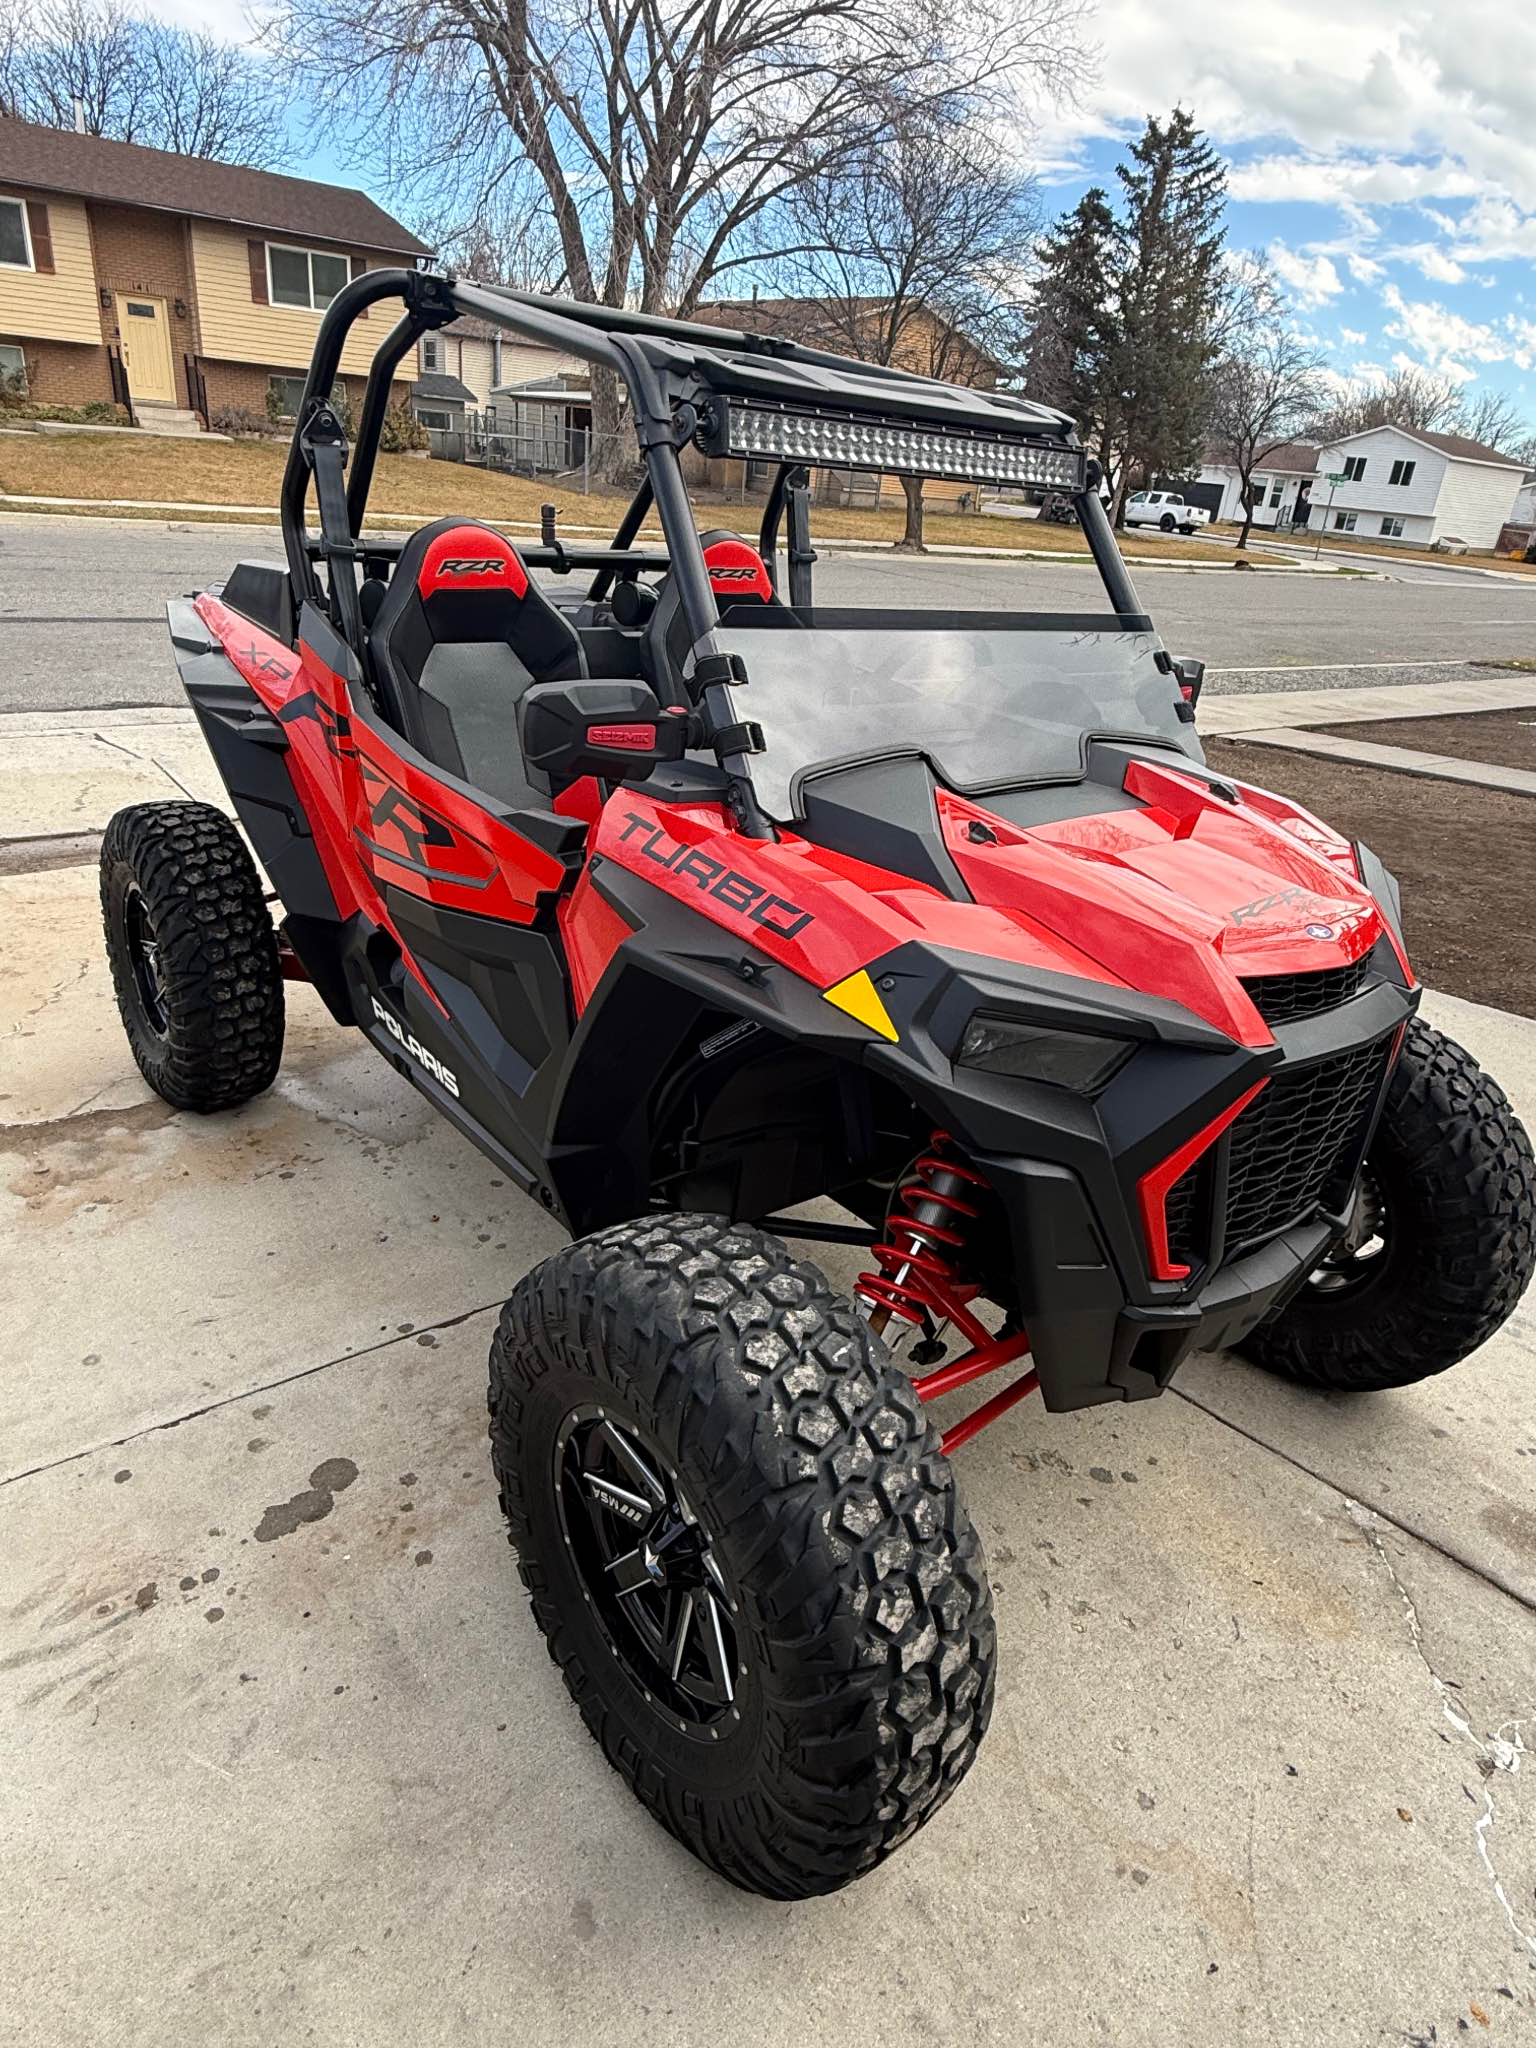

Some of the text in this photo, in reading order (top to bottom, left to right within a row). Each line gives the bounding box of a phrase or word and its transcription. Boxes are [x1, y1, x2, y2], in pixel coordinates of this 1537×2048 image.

[436, 558, 506, 577] RZR
[708, 567, 758, 581] RZR
[239, 640, 293, 681] XP
[619, 812, 816, 940] TURBO
[1231, 887, 1311, 927] RZR
[370, 995, 460, 1098] POLARIS
[591, 1485, 619, 1510] MSA
